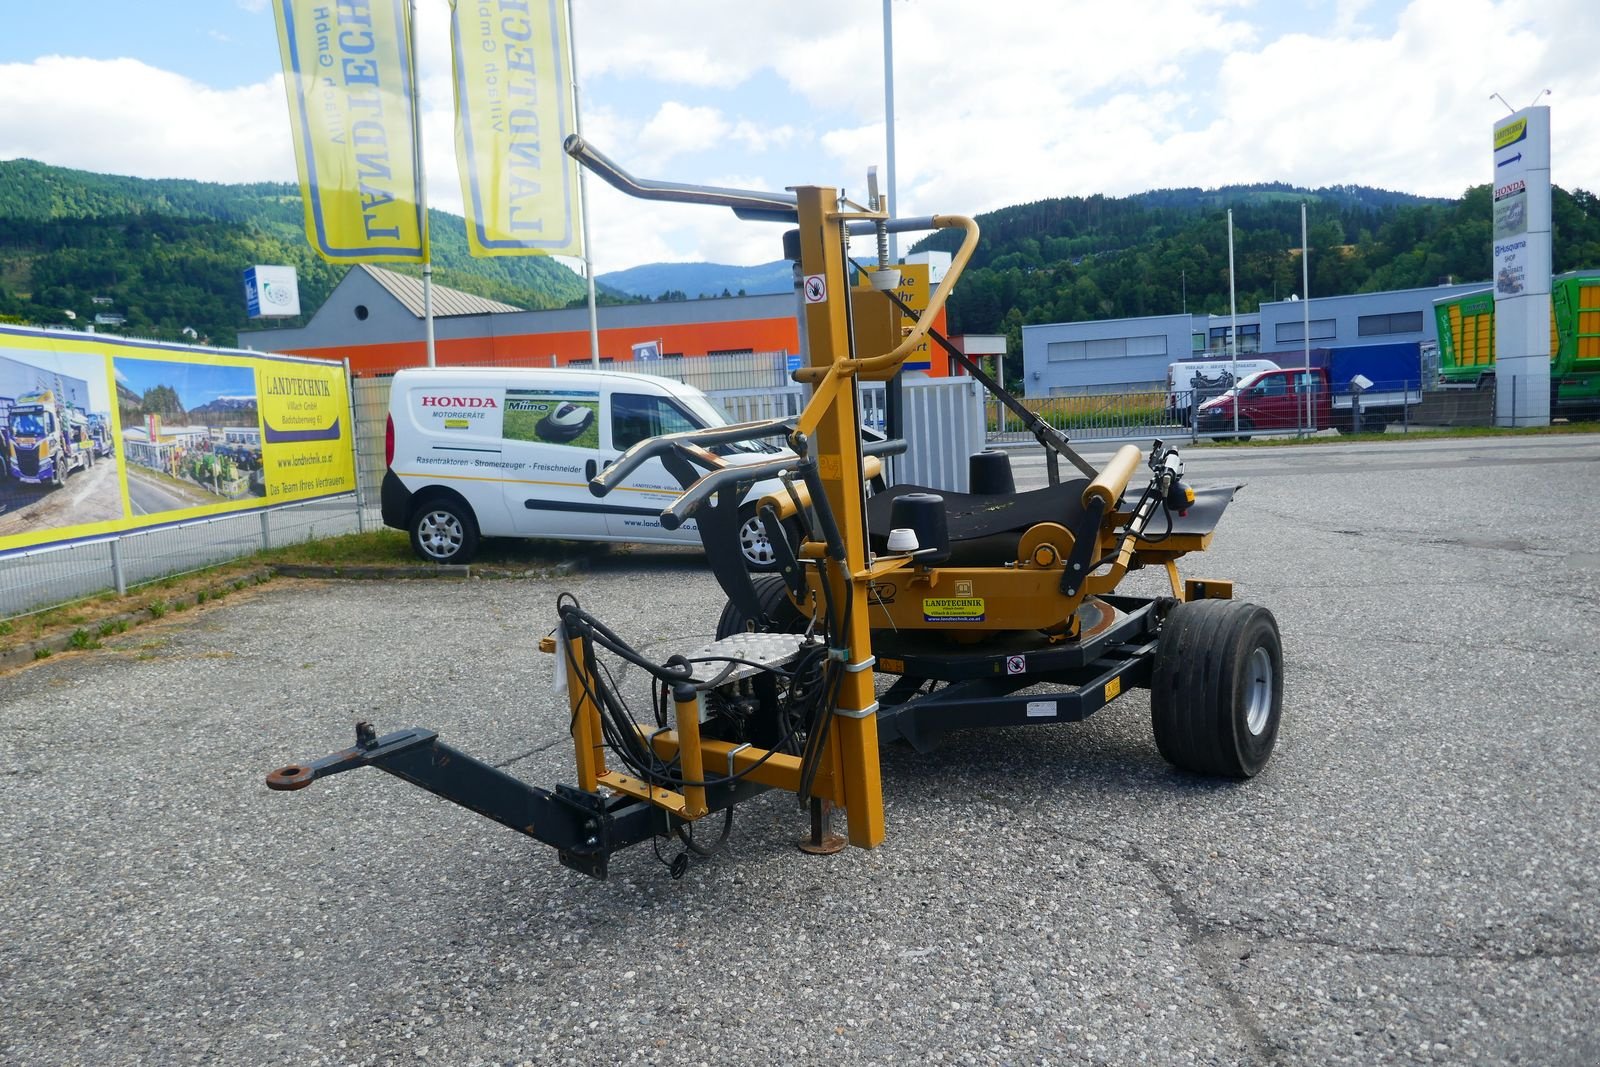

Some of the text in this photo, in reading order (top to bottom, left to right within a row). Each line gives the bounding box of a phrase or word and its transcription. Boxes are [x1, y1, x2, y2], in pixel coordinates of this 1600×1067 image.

[1495, 180, 1526, 197] HONDA
[266, 376, 330, 397] LANDTECHNIK
[287, 401, 318, 410] Villach GmbH
[422, 396, 498, 408] HONDA
[508, 401, 549, 411] Miimo
[432, 410, 486, 419] MOTORGERÄTE
[277, 453, 333, 468] www.landtechnik.co.at
[416, 456, 469, 467] Rasentraktoren
[475, 459, 526, 470] Stromerzeuger
[533, 462, 582, 473] Freischneider
[270, 476, 345, 496] Das Team Ihres Vertrauens
[925, 599, 982, 607] LANDTECHNIK
